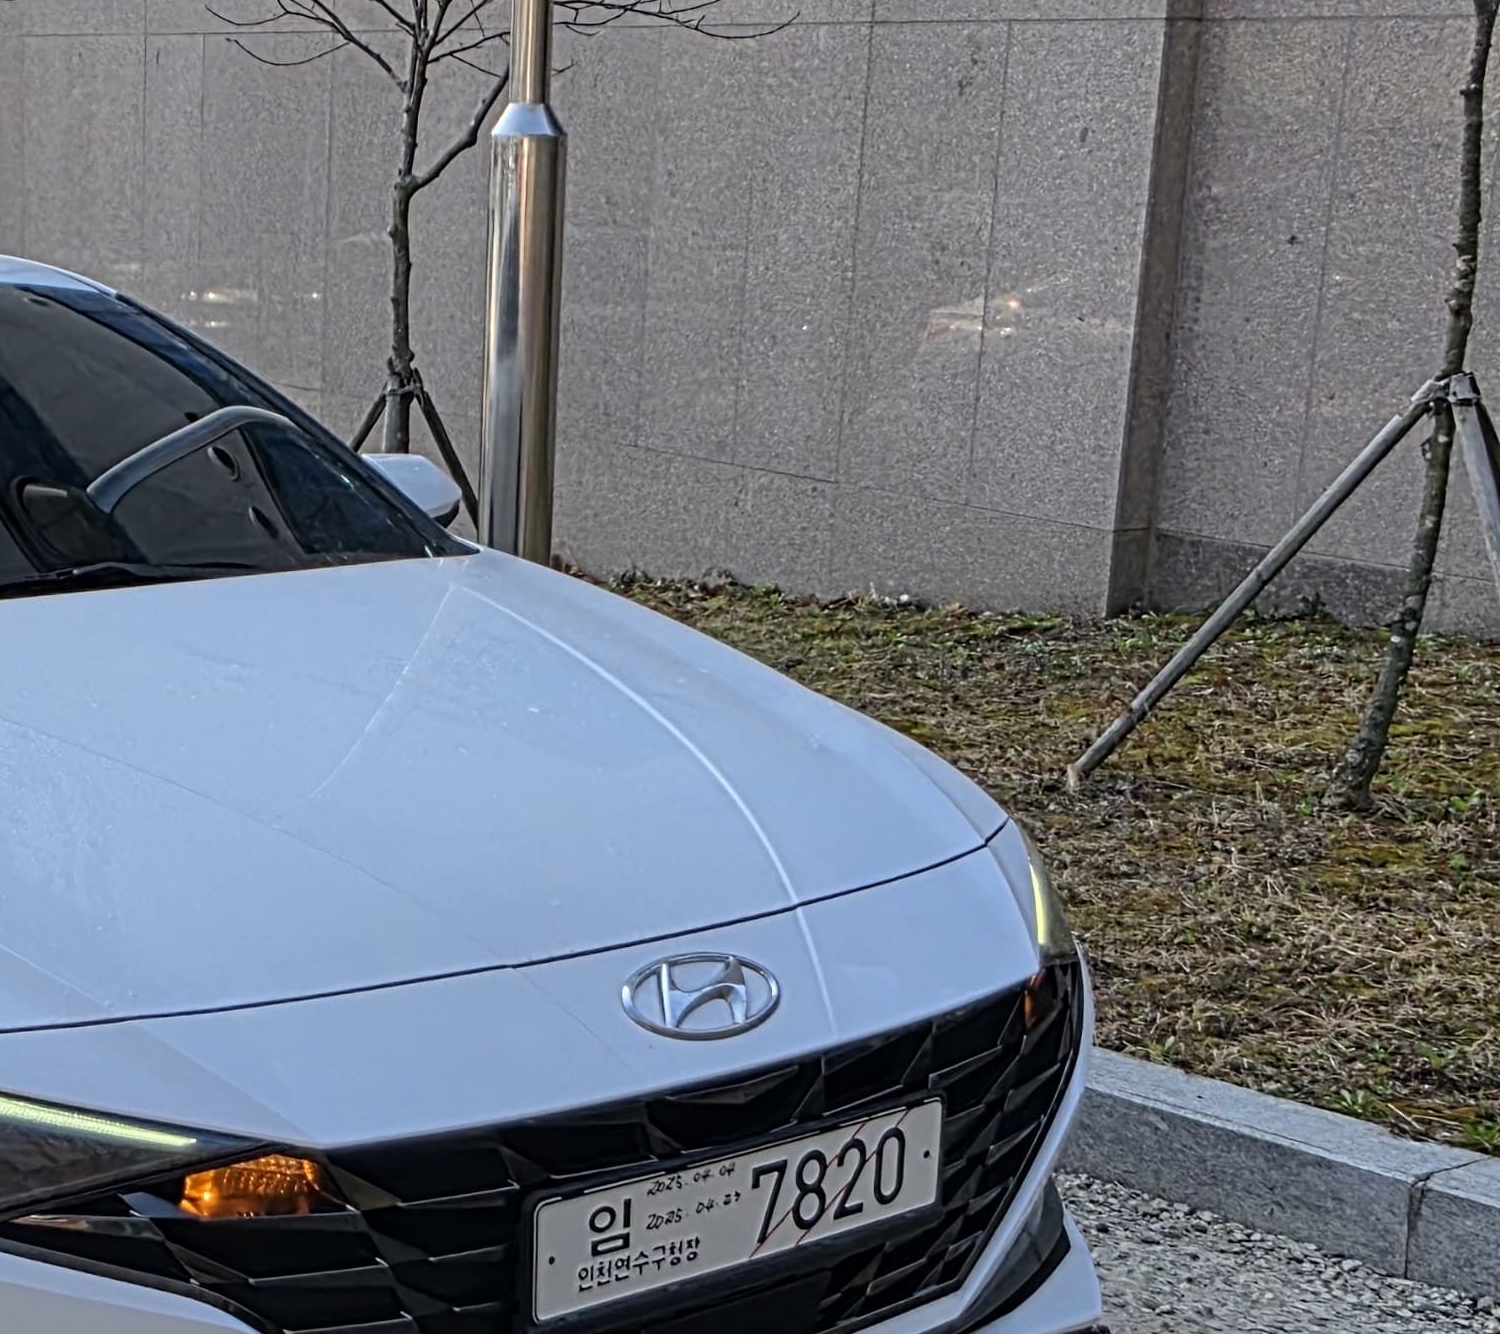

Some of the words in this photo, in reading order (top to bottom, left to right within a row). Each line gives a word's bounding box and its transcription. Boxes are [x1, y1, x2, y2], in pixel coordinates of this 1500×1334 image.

[589, 1198, 632, 1257] 임
[752, 1127, 905, 1244] 7820
[578, 1236, 700, 1292] 인천연수구청장
